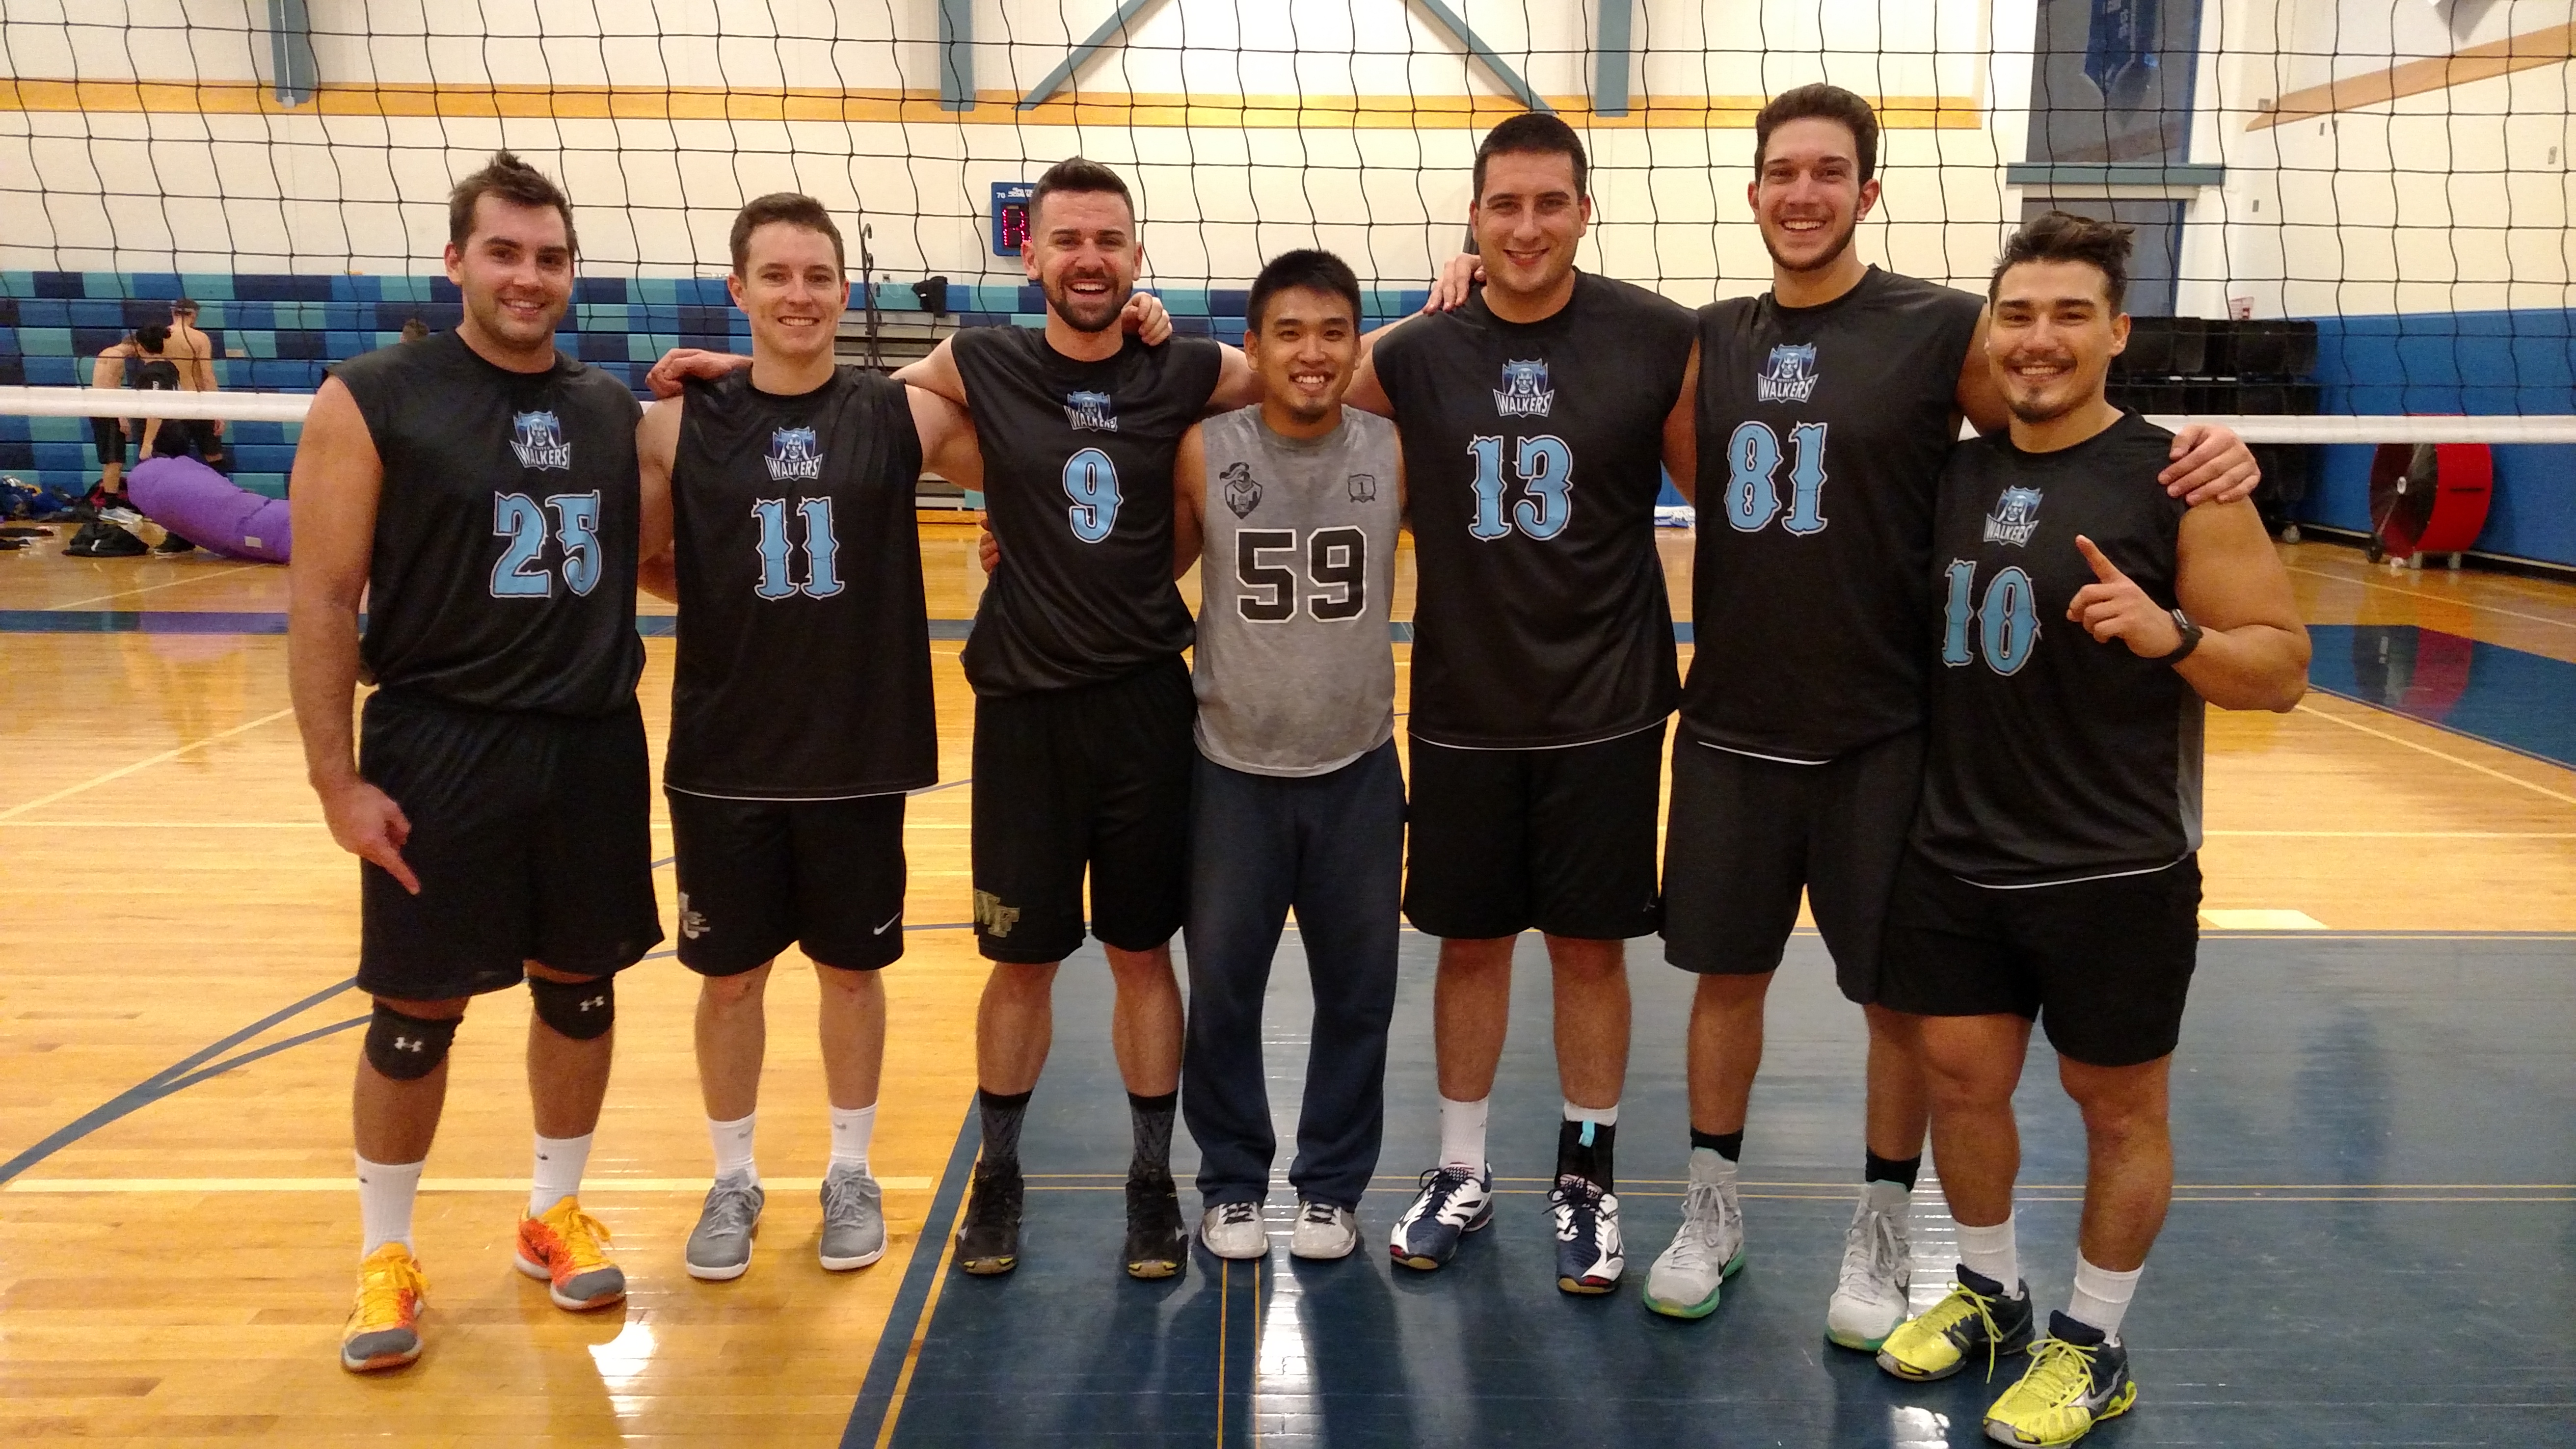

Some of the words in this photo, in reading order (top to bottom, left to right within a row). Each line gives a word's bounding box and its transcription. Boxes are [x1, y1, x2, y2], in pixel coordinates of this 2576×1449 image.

[1497, 393, 1551, 414] WALKERS
[1760, 377, 1814, 399] WALKERS
[514, 444, 568, 466] WALKERS
[769, 457, 820, 478] WALKERS
[1063, 447, 1124, 544] 9
[1358, 482, 1366, 494] 1
[1467, 434, 1573, 542] 13
[1724, 421, 1828, 537] 81
[490, 490, 602, 598] 25
[751, 496, 845, 601] 11
[1235, 525, 1368, 623] 59
[1986, 518, 2033, 543] WALKERS
[1942, 558, 2042, 677] 10
